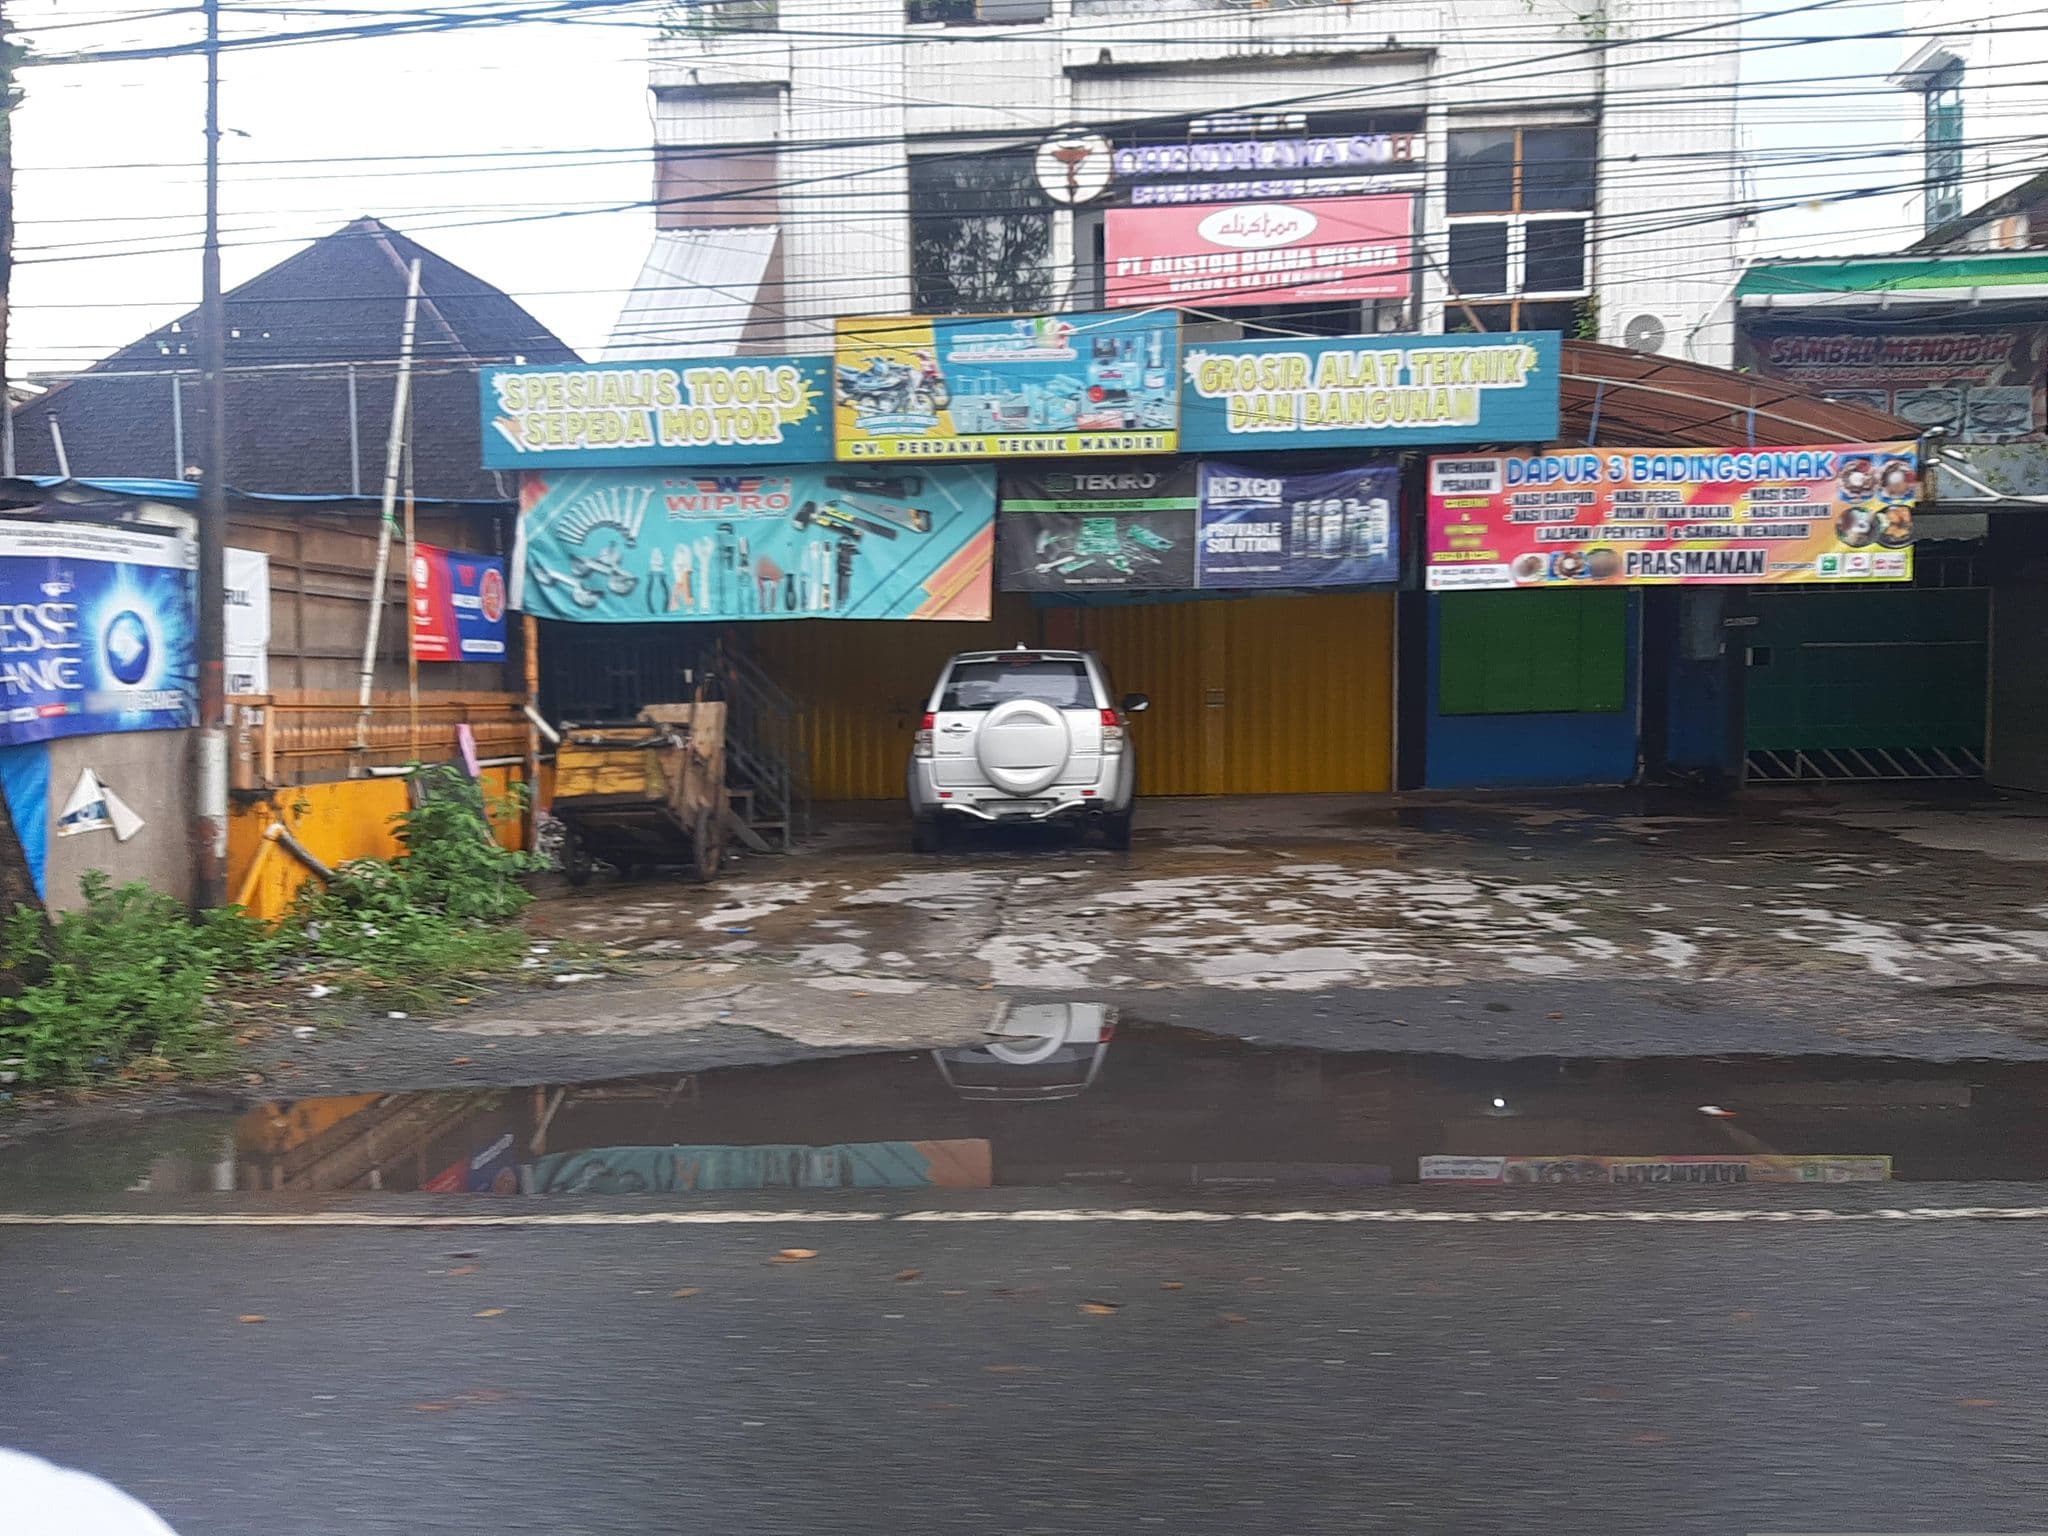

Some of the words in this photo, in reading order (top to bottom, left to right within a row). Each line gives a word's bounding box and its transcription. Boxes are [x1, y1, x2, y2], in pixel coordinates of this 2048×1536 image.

[1200, 356, 1308, 392] GROSIR
[1320, 351, 1399, 388] ALAT
[1411, 348, 1524, 385] TEKNIK
[504, 370, 678, 411] SPESIALIS
[689, 369, 797, 406] TOOLS
[1232, 394, 1294, 427] DAN
[526, 411, 651, 446] SEPEDA
[662, 407, 779, 442] MOTOR
[897, 440, 987, 454] PERDANA
[998, 437, 1067, 452] TEKNIK
[1079, 436, 1164, 450] MANDIRI
[1507, 456, 1601, 485] DAPUR
[1608, 457, 1626, 482] 3
[1631, 452, 1835, 483] BADINGSANAK
[1073, 474, 1156, 492] TEKIRO
[1208, 477, 1282, 496] REXCO
[665, 493, 791, 512] WIPRO
[1626, 551, 1764, 575] PRASMANAN
